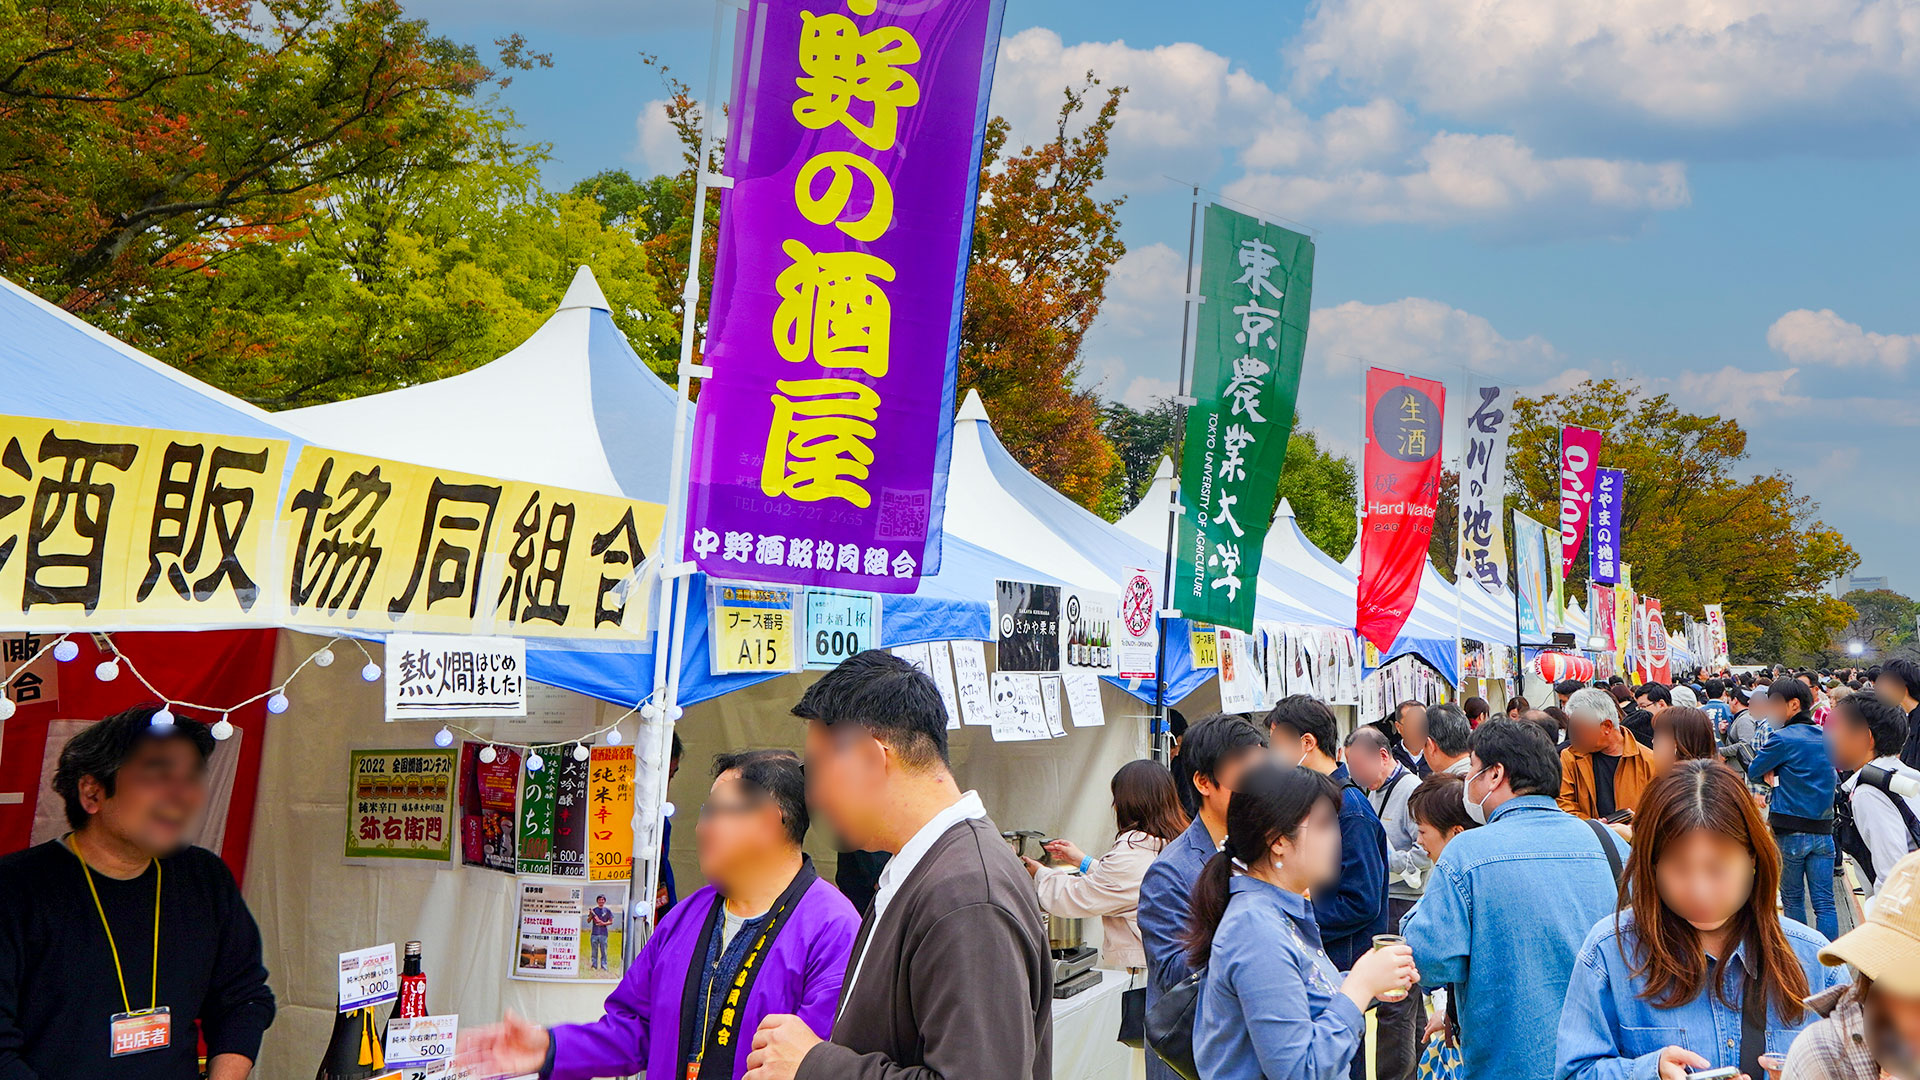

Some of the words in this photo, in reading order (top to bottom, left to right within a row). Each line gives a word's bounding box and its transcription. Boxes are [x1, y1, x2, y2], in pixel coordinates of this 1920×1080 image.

[761, 0, 921, 508] 野の酒屋
[1207, 412, 1219, 449] TOKYO
[1208, 237, 1284, 602] 東京農業大学
[1398, 394, 1426, 457] 生酒
[1200, 452, 1214, 510] UNIVERSITY
[1464, 386, 1504, 588] 石川の地酒
[1197, 511, 1208, 527] OF
[1368, 501, 1404, 515] Hard
[1407, 502, 1436, 518] Water
[1598, 475, 1615, 578] とやまの地酒
[0, 428, 647, 629] 酒販協同組合
[692, 527, 917, 579] 中野酒販協同組合
[1193, 528, 1206, 597] AGRICULTURE
[728, 612, 784, 631] ブース番号
[1016, 619, 1057, 636] さかや栗原
[476, 653, 516, 672] はじめ
[738, 639, 777, 665] A15
[360, 758, 385, 774] 2022
[358, 802, 397, 814] 純米辛口
[592, 767, 617, 841] 純米辛口
[360, 816, 443, 842] 弥右衛門
[116, 1028, 167, 1051] 出店者
